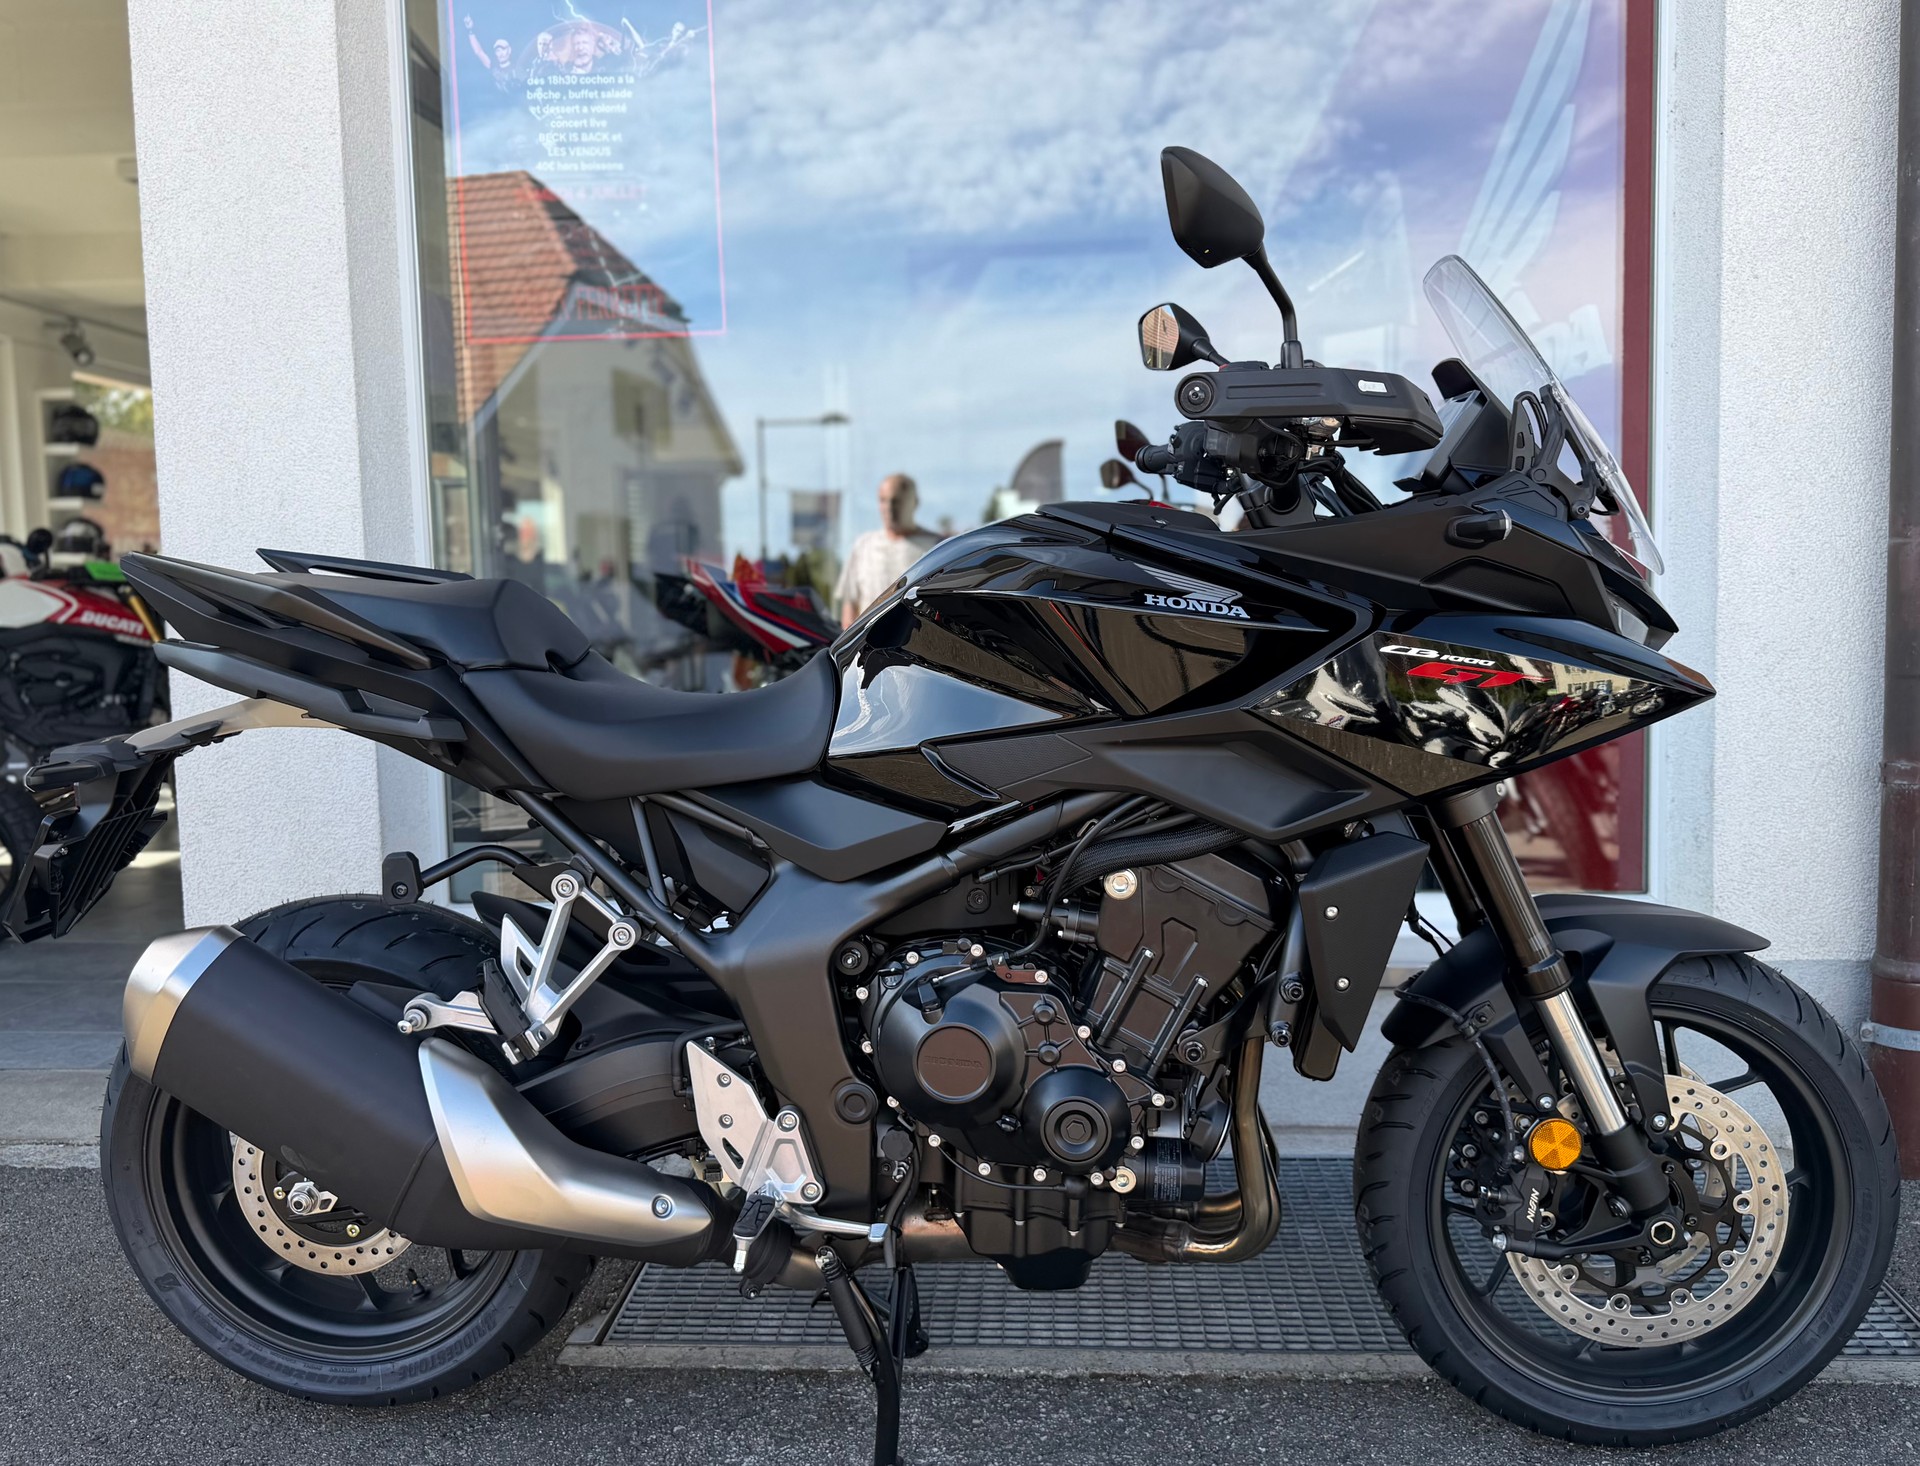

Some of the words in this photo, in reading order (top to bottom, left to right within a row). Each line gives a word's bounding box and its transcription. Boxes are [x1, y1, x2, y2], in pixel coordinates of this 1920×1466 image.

[548, 75, 577, 86] 18h30
[579, 74, 615, 85] cochon
[625, 74, 635, 85] la
[568, 89, 599, 100] buffet
[601, 88, 633, 99] salade
[529, 104, 540, 114] et
[542, 104, 580, 115] dessert
[590, 103, 627, 114] volonté
[550, 118, 588, 129] concert
[590, 118, 608, 129] live
[538, 132, 566, 143] BECK
[569, 132, 579, 143] IS
[581, 132, 610, 143] BACK
[547, 146, 567, 157] LES
[569, 146, 612, 157] VENDUS
[1144, 593, 1251, 619] HONDA
[80, 610, 144, 635] DUCATI
[1407, 661, 1549, 689] GT
[924, 1055, 985, 1070] HONDA
[394, 1312, 501, 1381] BRIDGESTONE
